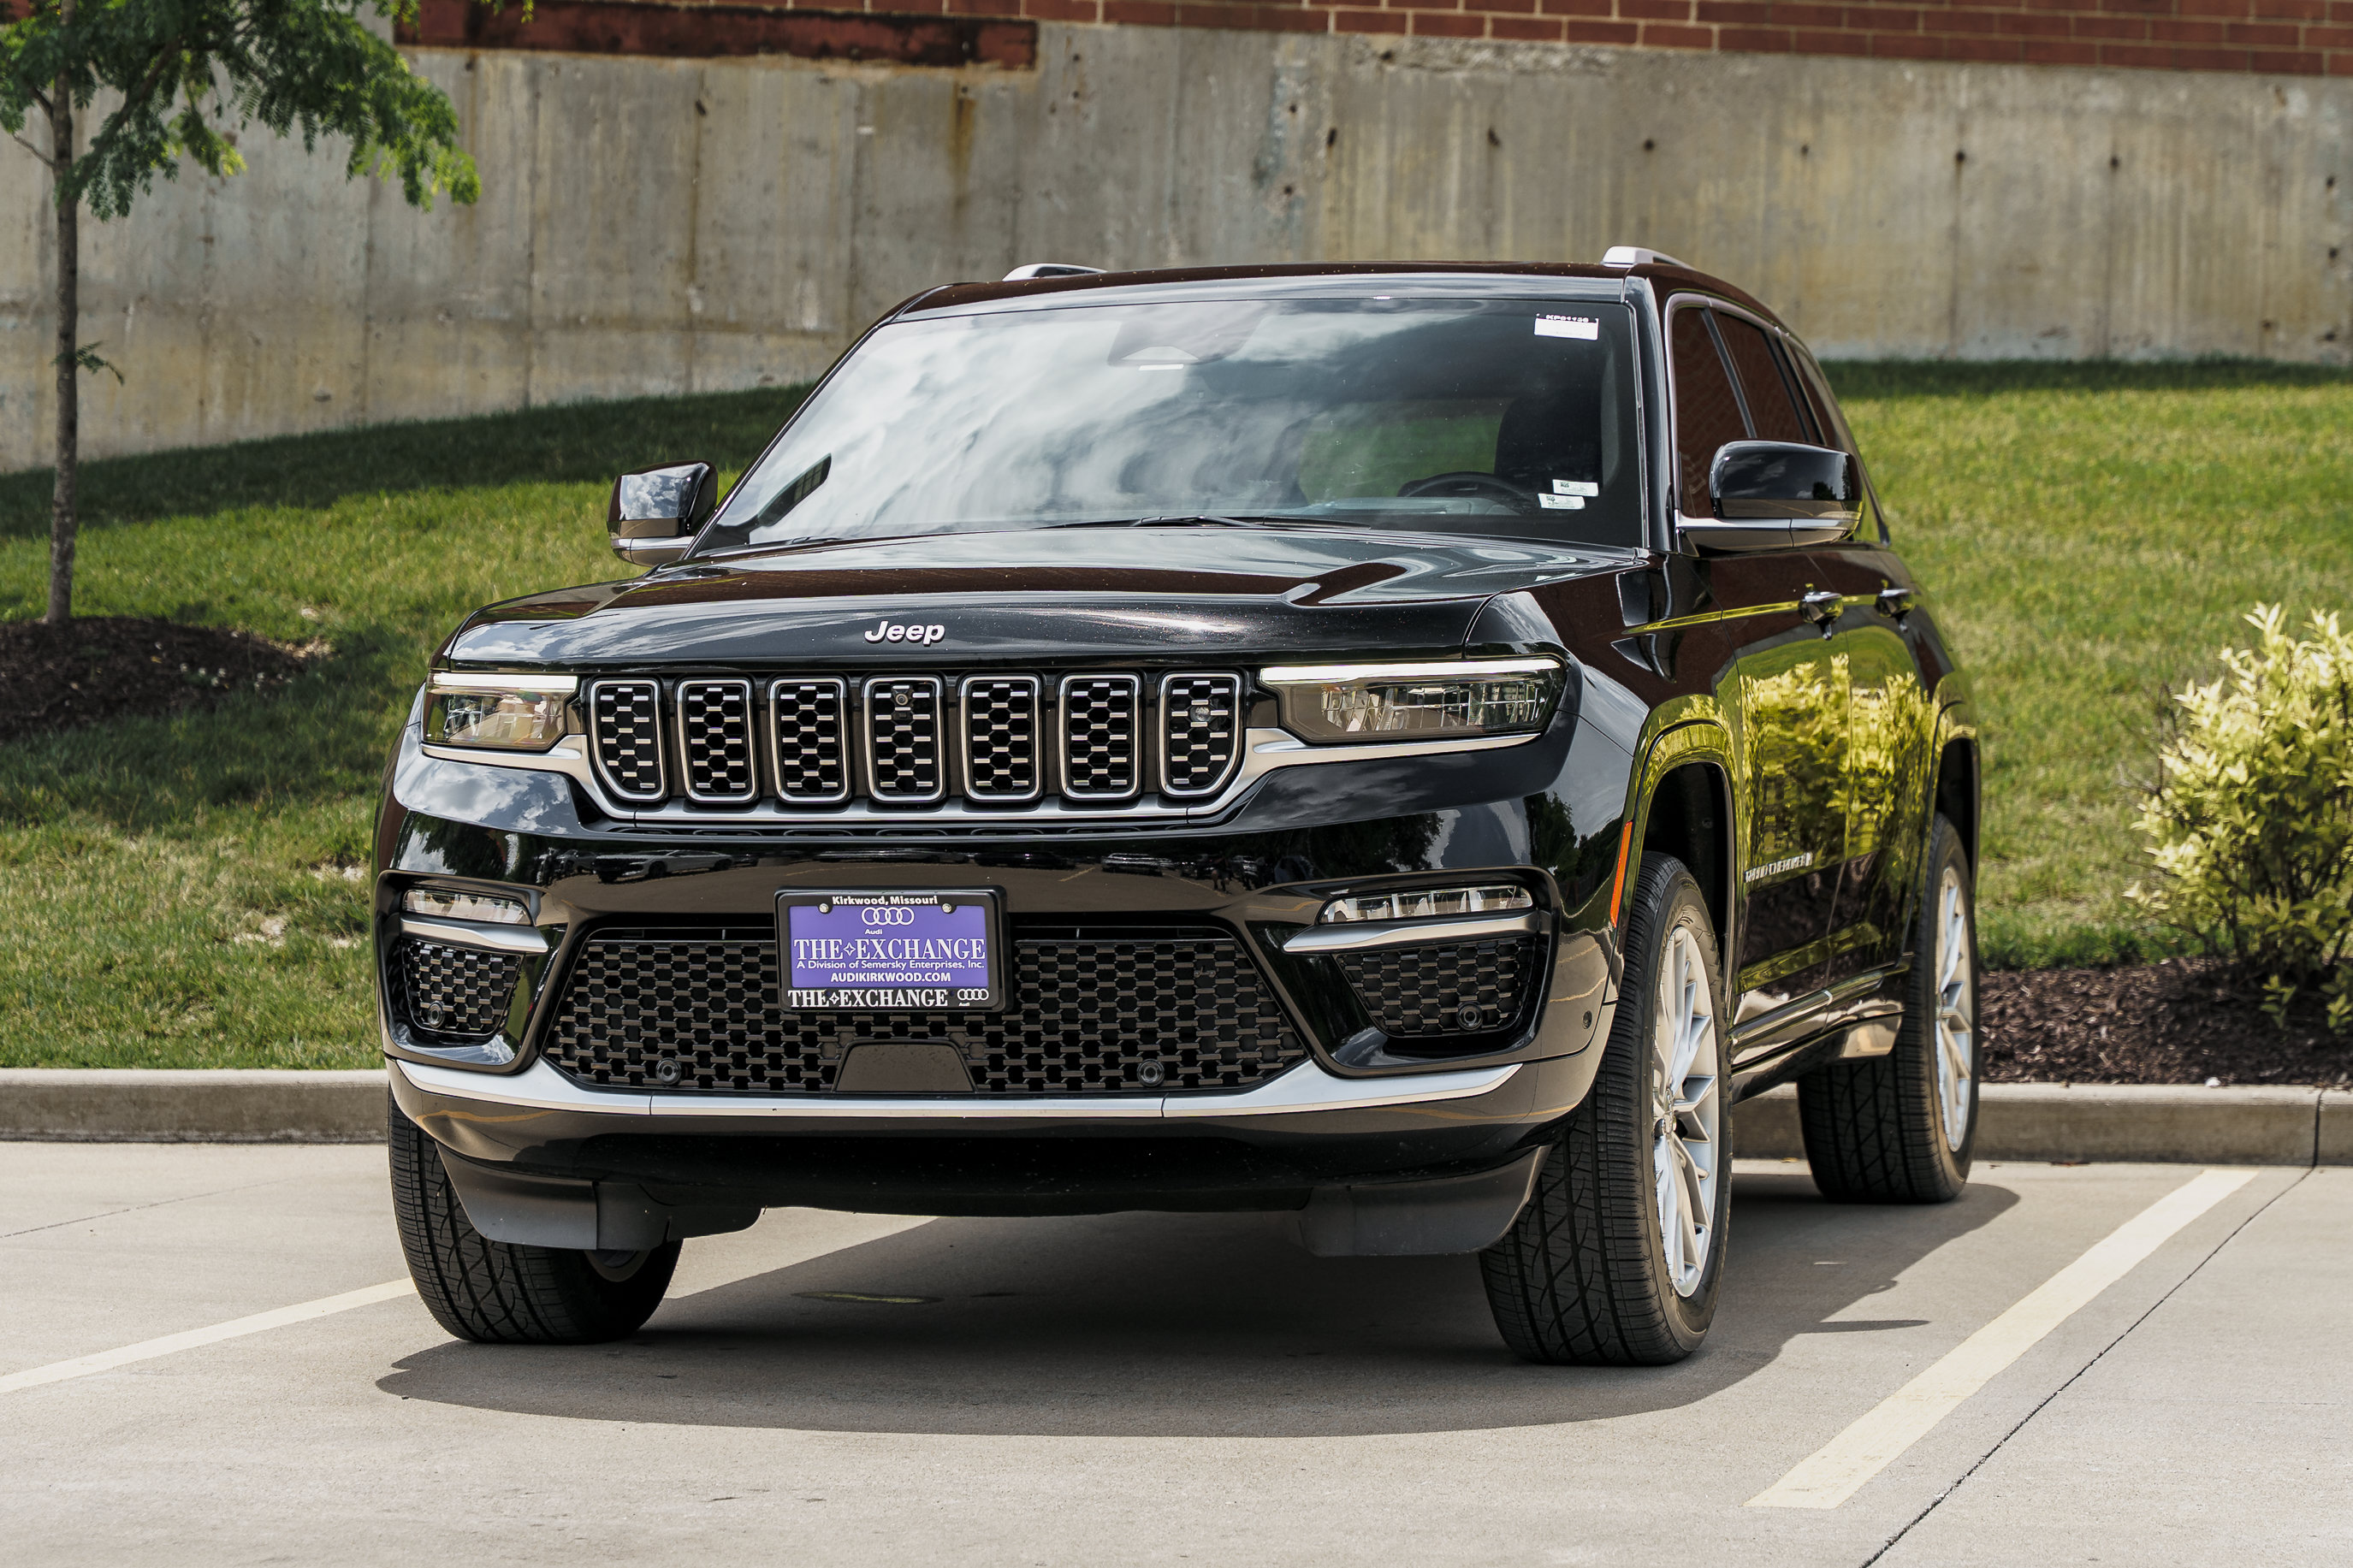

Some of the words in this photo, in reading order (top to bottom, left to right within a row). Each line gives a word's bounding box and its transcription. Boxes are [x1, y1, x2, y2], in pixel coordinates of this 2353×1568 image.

[864, 620, 945, 645] Jeep
[832, 896, 888, 905] Kirkwood,
[890, 896, 938, 904] Missouri
[793, 938, 844, 960] THE
[855, 938, 985, 960] EXCHANGE
[808, 960, 845, 968] Division
[849, 960, 858, 968] of
[861, 961, 906, 970] Semersky
[910, 960, 965, 970] Enterprises,
[830, 972, 951, 982] AUDIKIRKWOOD.COM
[787, 990, 829, 1008] THE
[839, 989, 948, 1007] EXCHANGE
